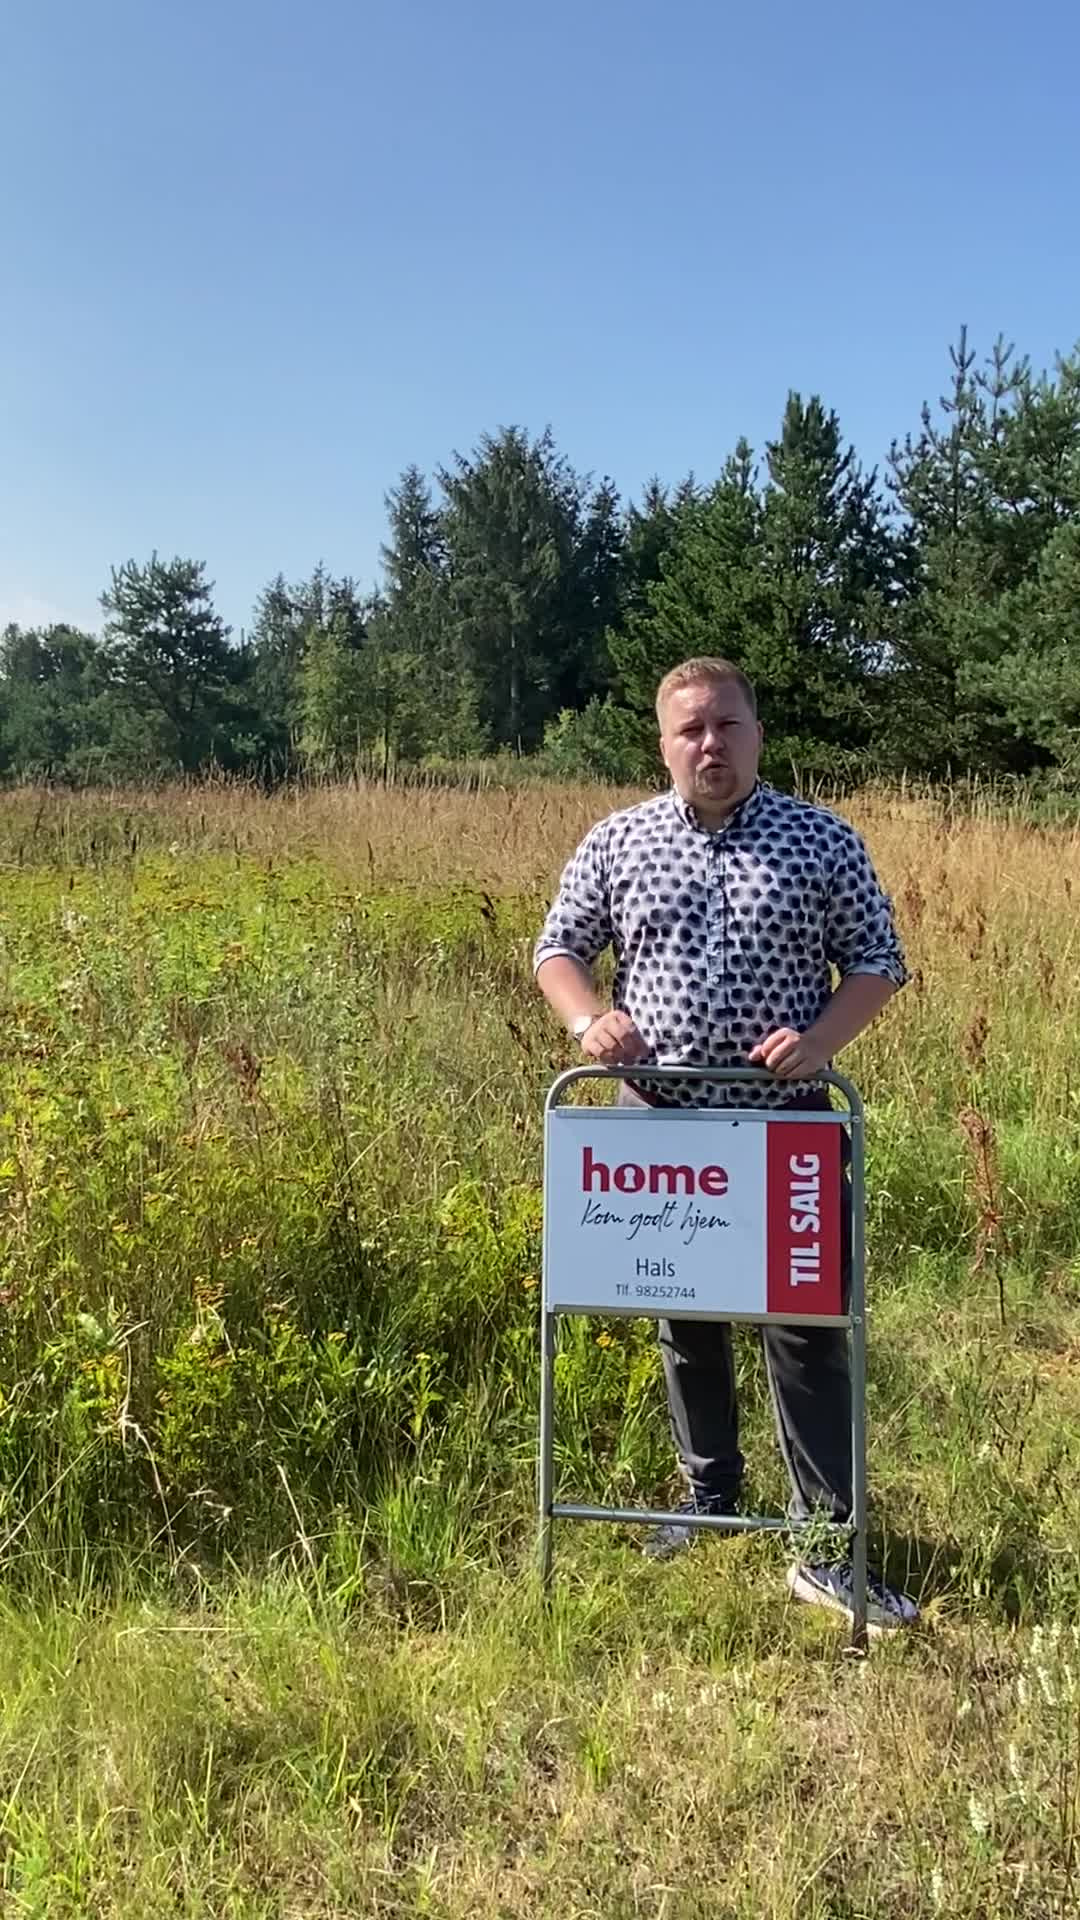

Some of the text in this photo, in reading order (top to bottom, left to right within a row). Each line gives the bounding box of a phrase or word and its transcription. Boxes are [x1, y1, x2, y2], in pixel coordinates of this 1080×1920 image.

[582, 1146, 729, 1196] home
[580, 1198, 731, 1245] Kom godt hjem
[789, 1153, 820, 1286] TIL SALG
[635, 1258, 676, 1278] Hals
[616, 1284, 696, 1300] Tlf. 98252744
